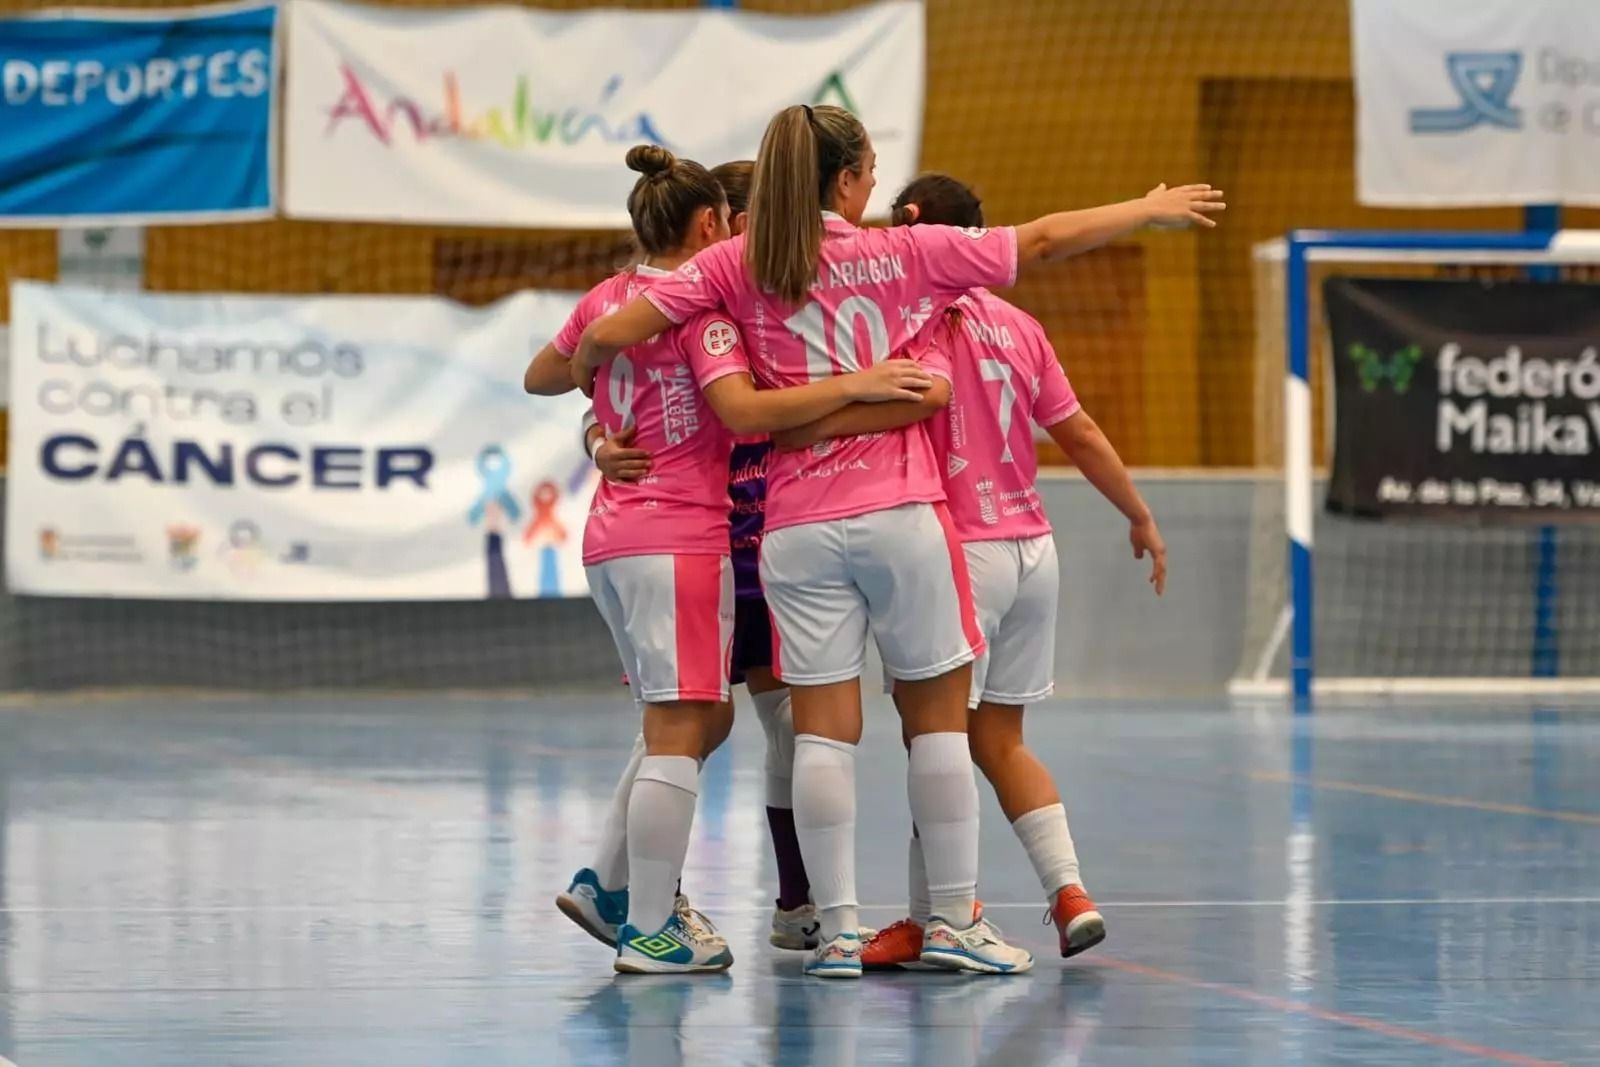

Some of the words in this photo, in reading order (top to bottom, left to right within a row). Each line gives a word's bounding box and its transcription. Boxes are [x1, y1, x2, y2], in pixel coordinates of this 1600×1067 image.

[3, 50, 268, 106] DEPORTES
[829, 252, 907, 290] ARAGÓN
[36, 323, 363, 376] Luchamos
[784, 296, 890, 383] 10
[36, 375, 258, 425] contra
[281, 384, 334, 425] el
[603, 351, 636, 440] 9
[979, 358, 1016, 463] 7
[1436, 401, 1589, 454] Maika
[38, 424, 436, 489] CÁNCER
